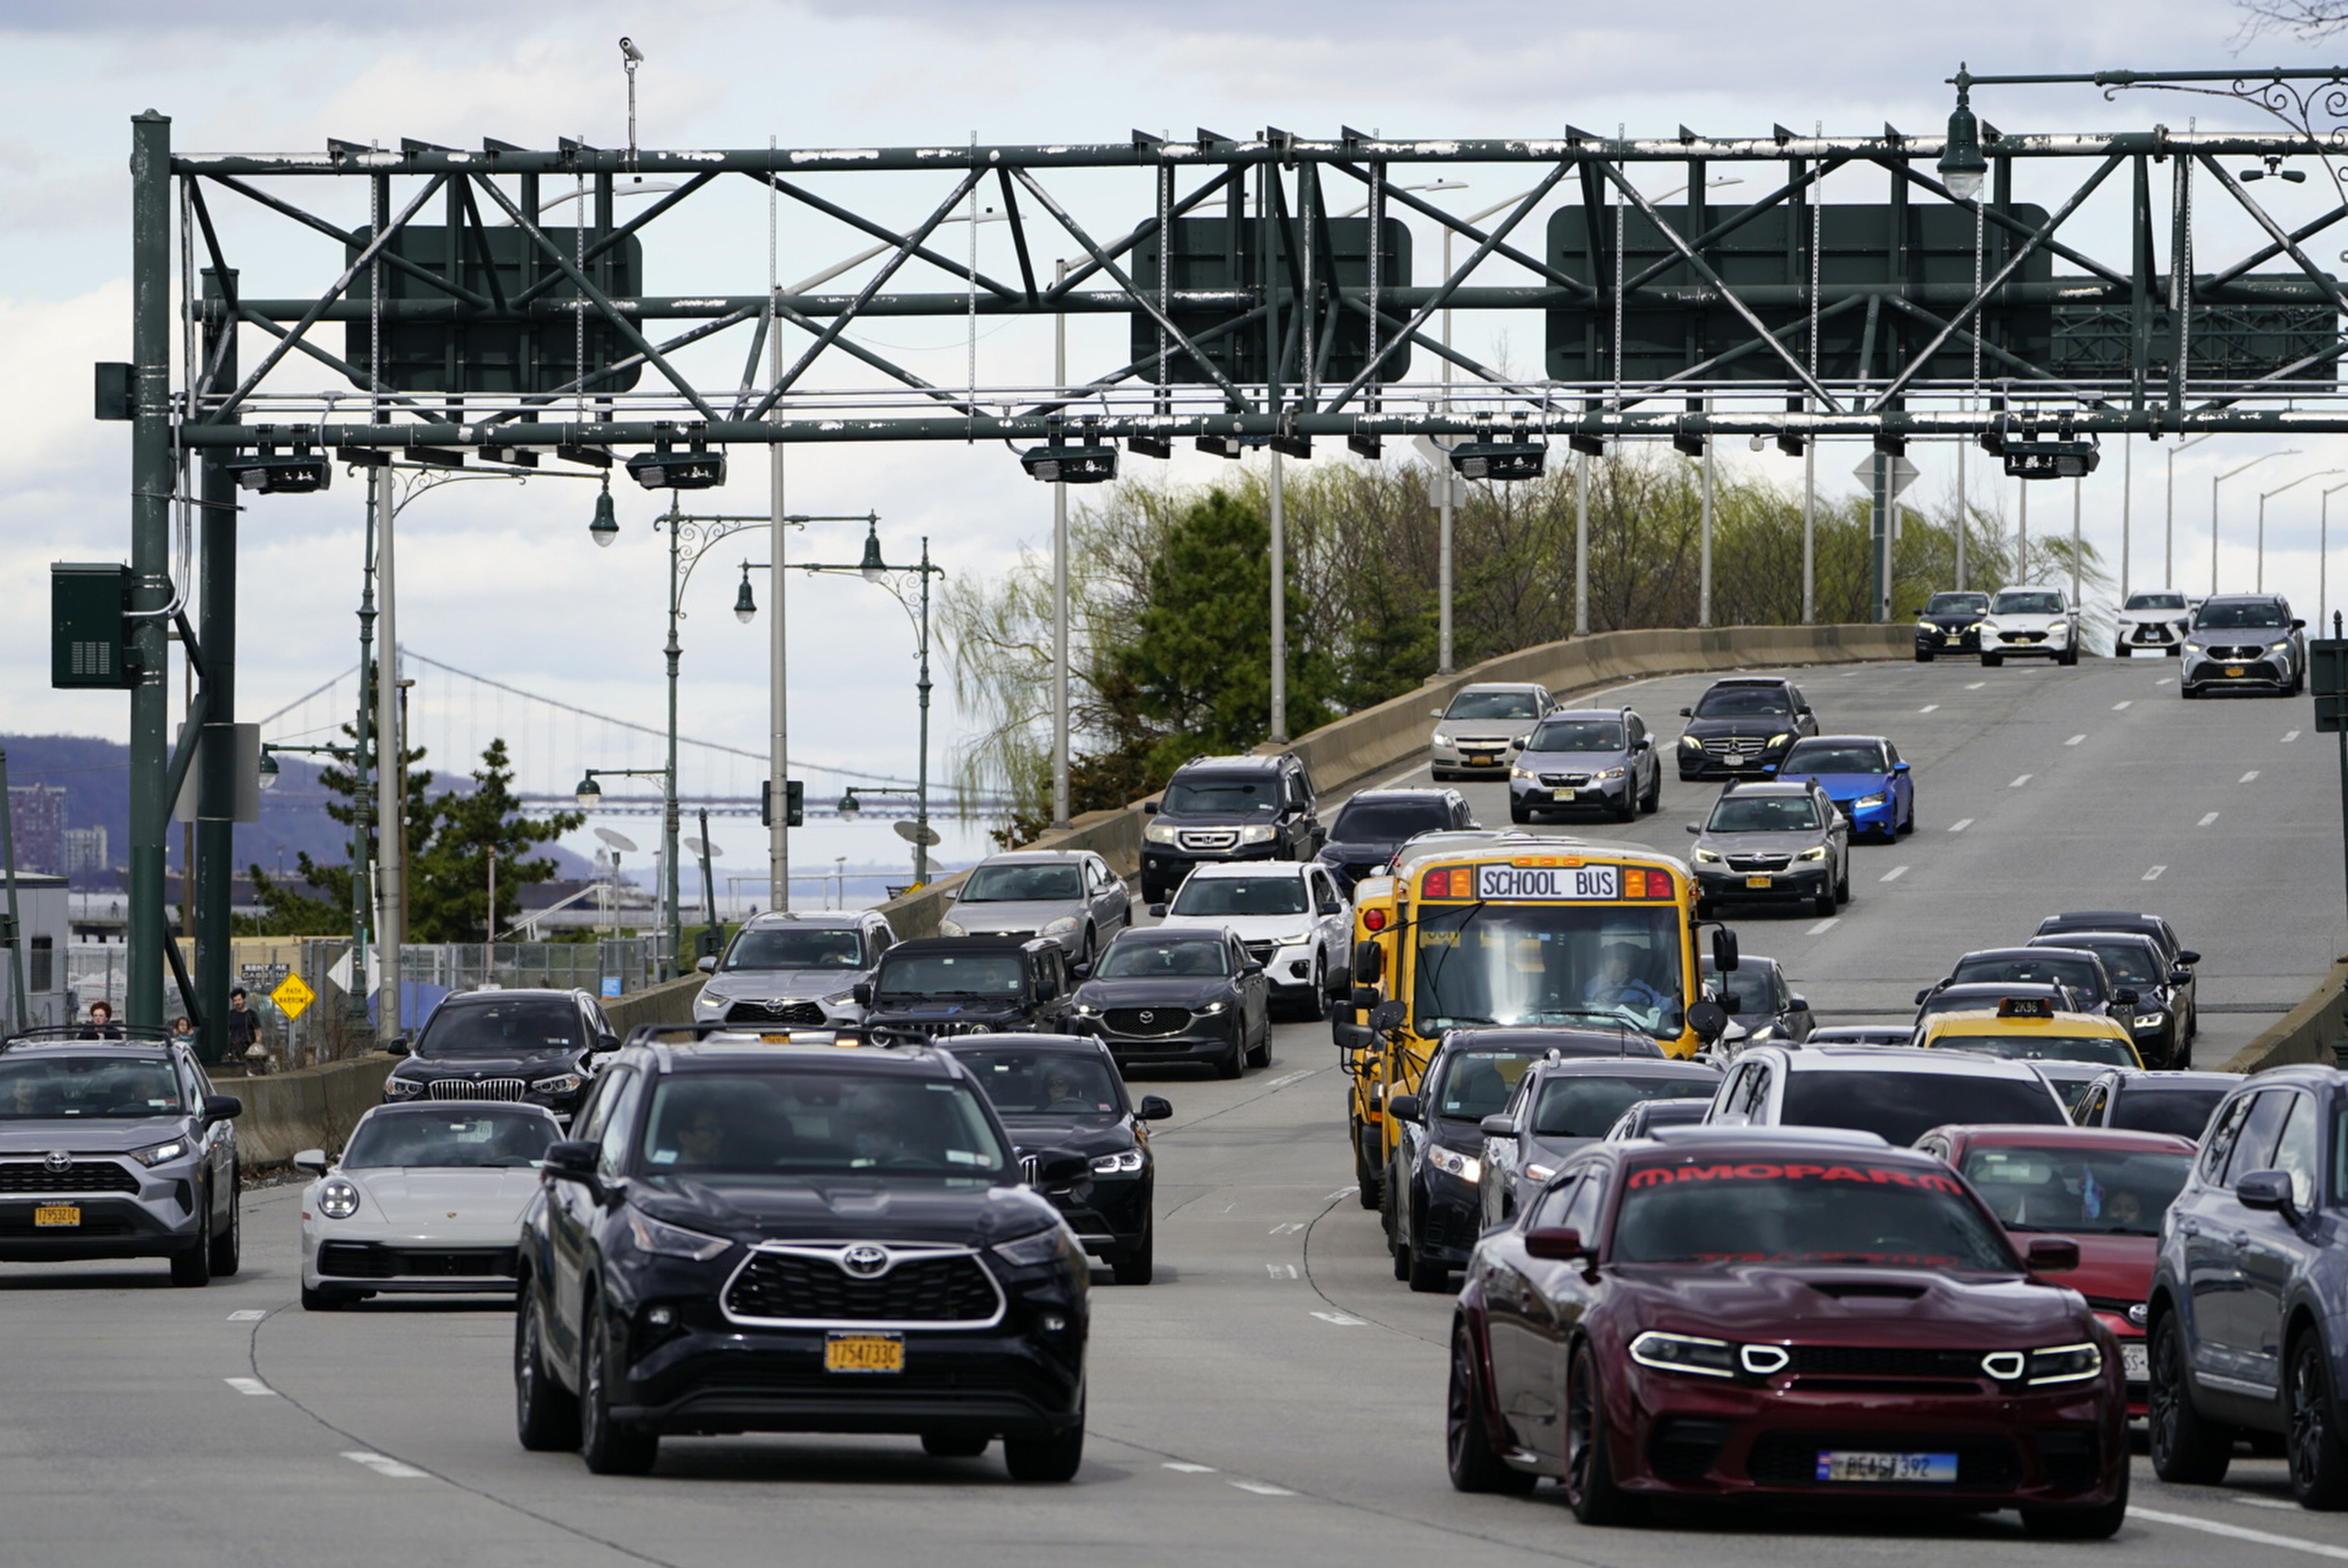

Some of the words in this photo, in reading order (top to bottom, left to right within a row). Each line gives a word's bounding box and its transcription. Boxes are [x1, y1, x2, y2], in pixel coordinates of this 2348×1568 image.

[1482, 871, 1561, 896] SCHOOL
[1576, 871, 1614, 896] BUS
[2014, 1002, 2038, 1012] 2K96
[1676, 1164, 1916, 1186] MOPAR
[38, 1209, 78, 1221] T795321C
[833, 1343, 896, 1364] T754733C
